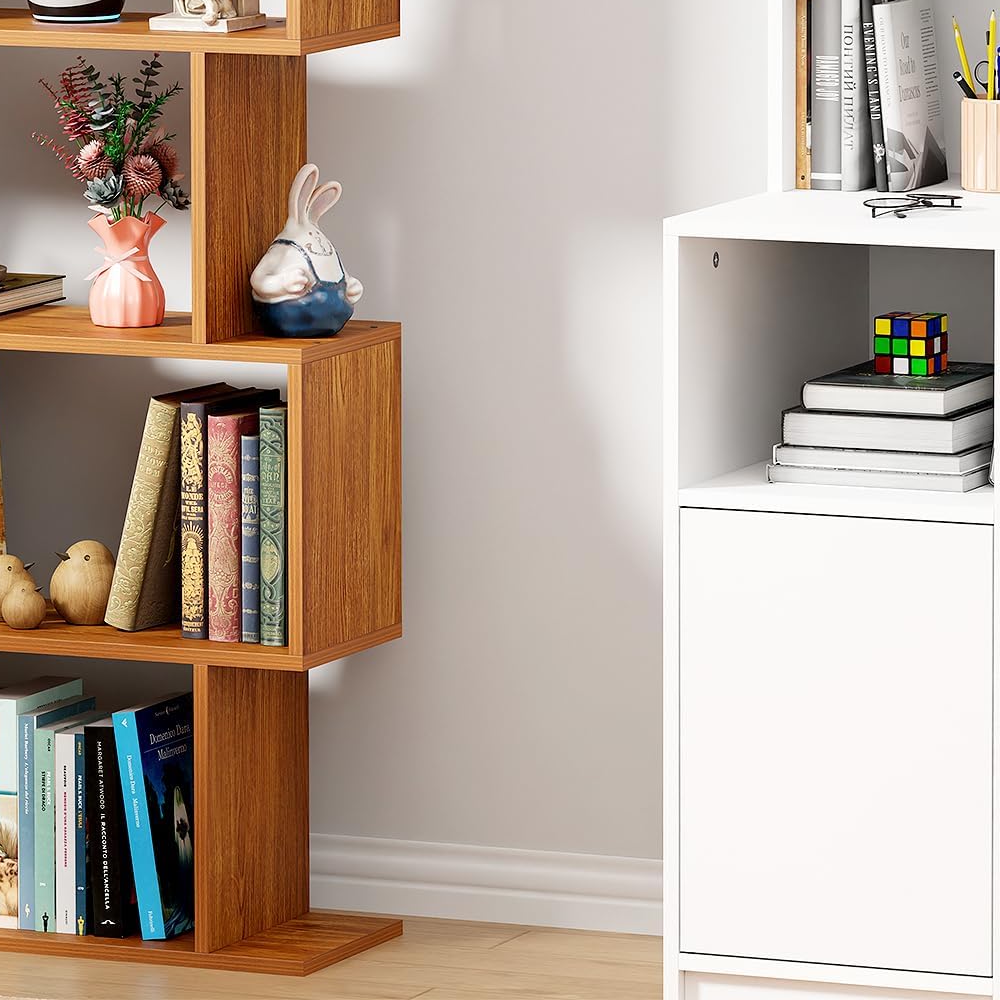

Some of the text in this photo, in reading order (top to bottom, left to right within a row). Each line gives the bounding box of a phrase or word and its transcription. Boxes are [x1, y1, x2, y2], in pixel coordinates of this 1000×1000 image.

[814, 55, 840, 102] DAMAGED JOY
[843, 24, 857, 151] ПОНТИЙ ПИЛАТ
[863, 22, 881, 120] EVENING'S LAND
[96, 741, 105, 778] MARGARET
[100, 821, 109, 859] RACCONTO
[102, 860, 111, 911] DELL'ANCELLA
